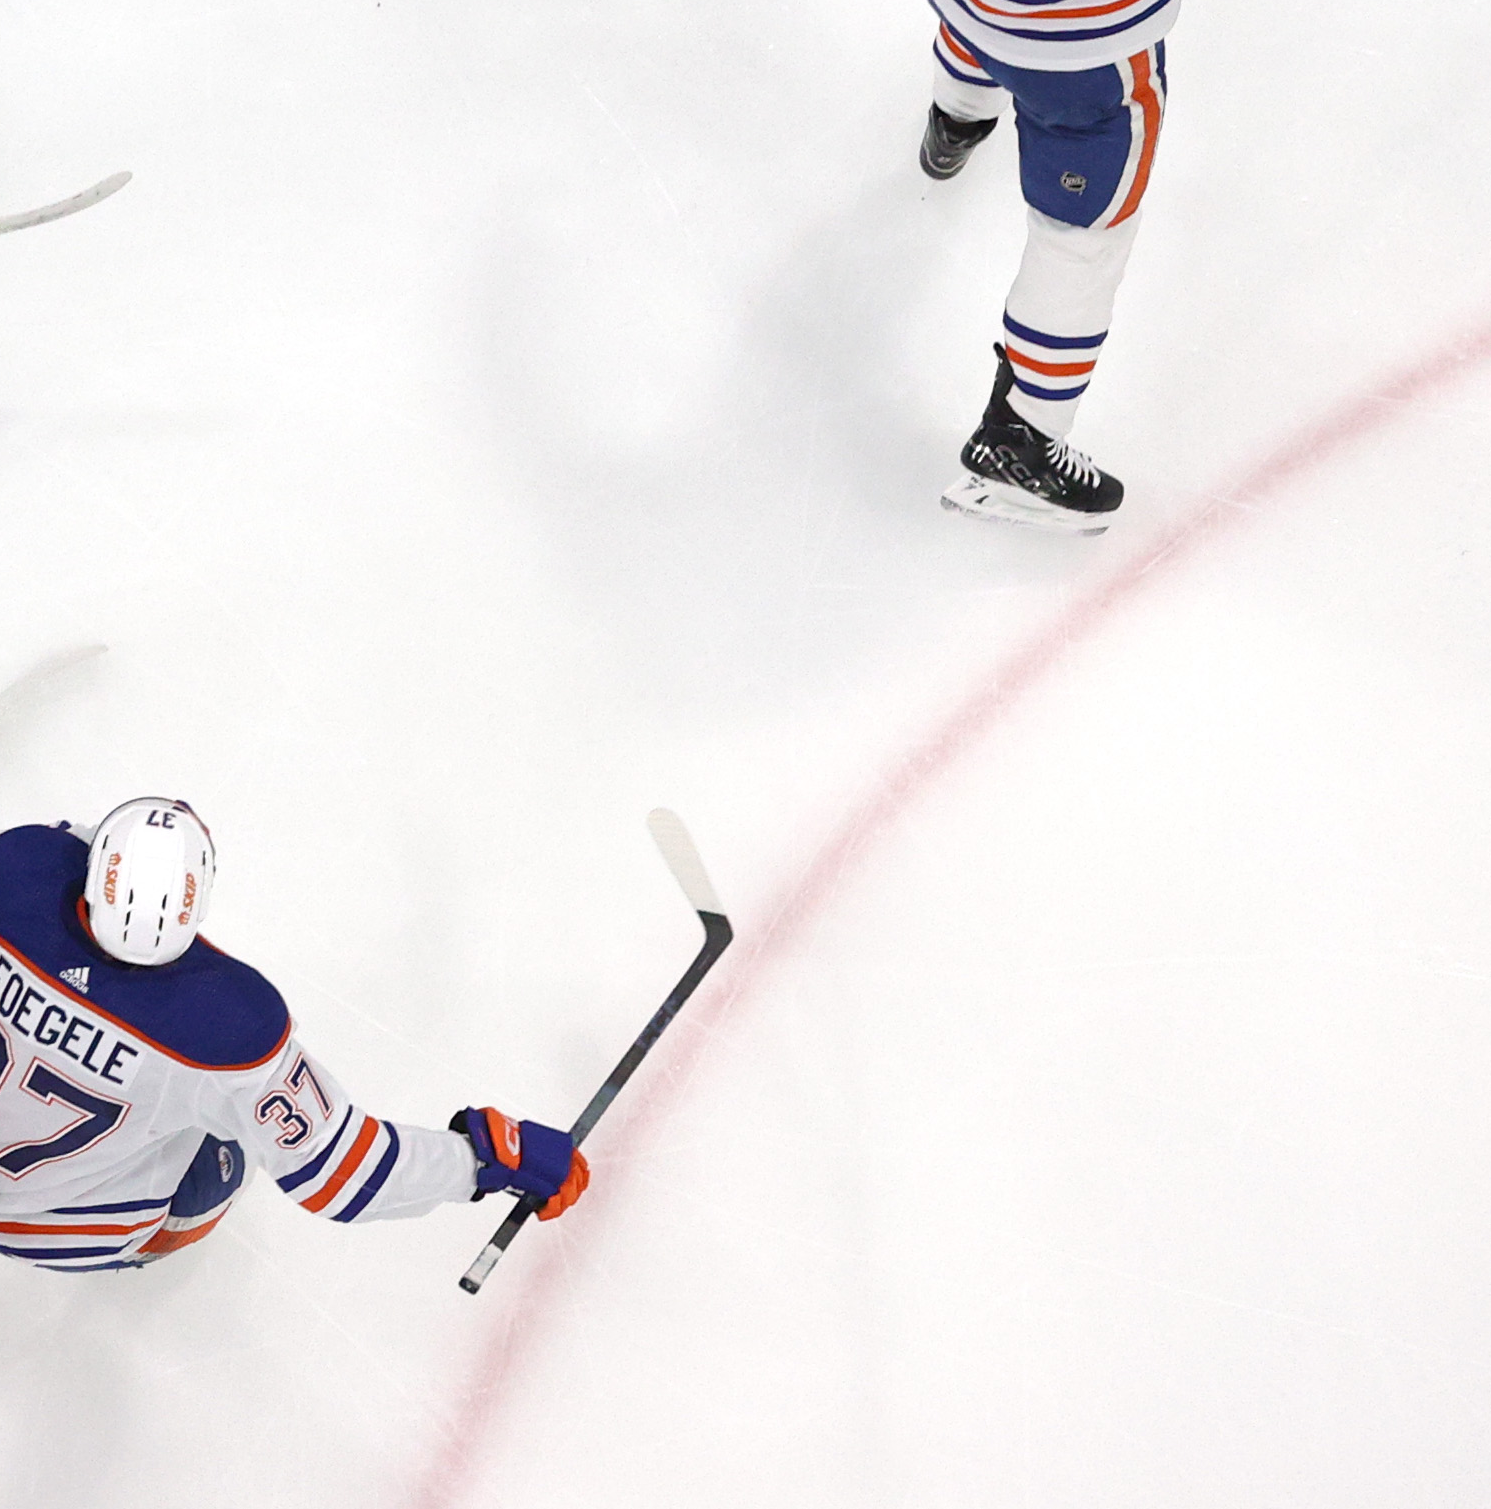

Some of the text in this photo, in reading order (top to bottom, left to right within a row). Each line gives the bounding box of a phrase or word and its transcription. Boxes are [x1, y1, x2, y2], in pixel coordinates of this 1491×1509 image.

[145, 809, 177, 830] 37
[104, 866, 119, 905] SKIP
[255, 1051, 335, 1149] 37
